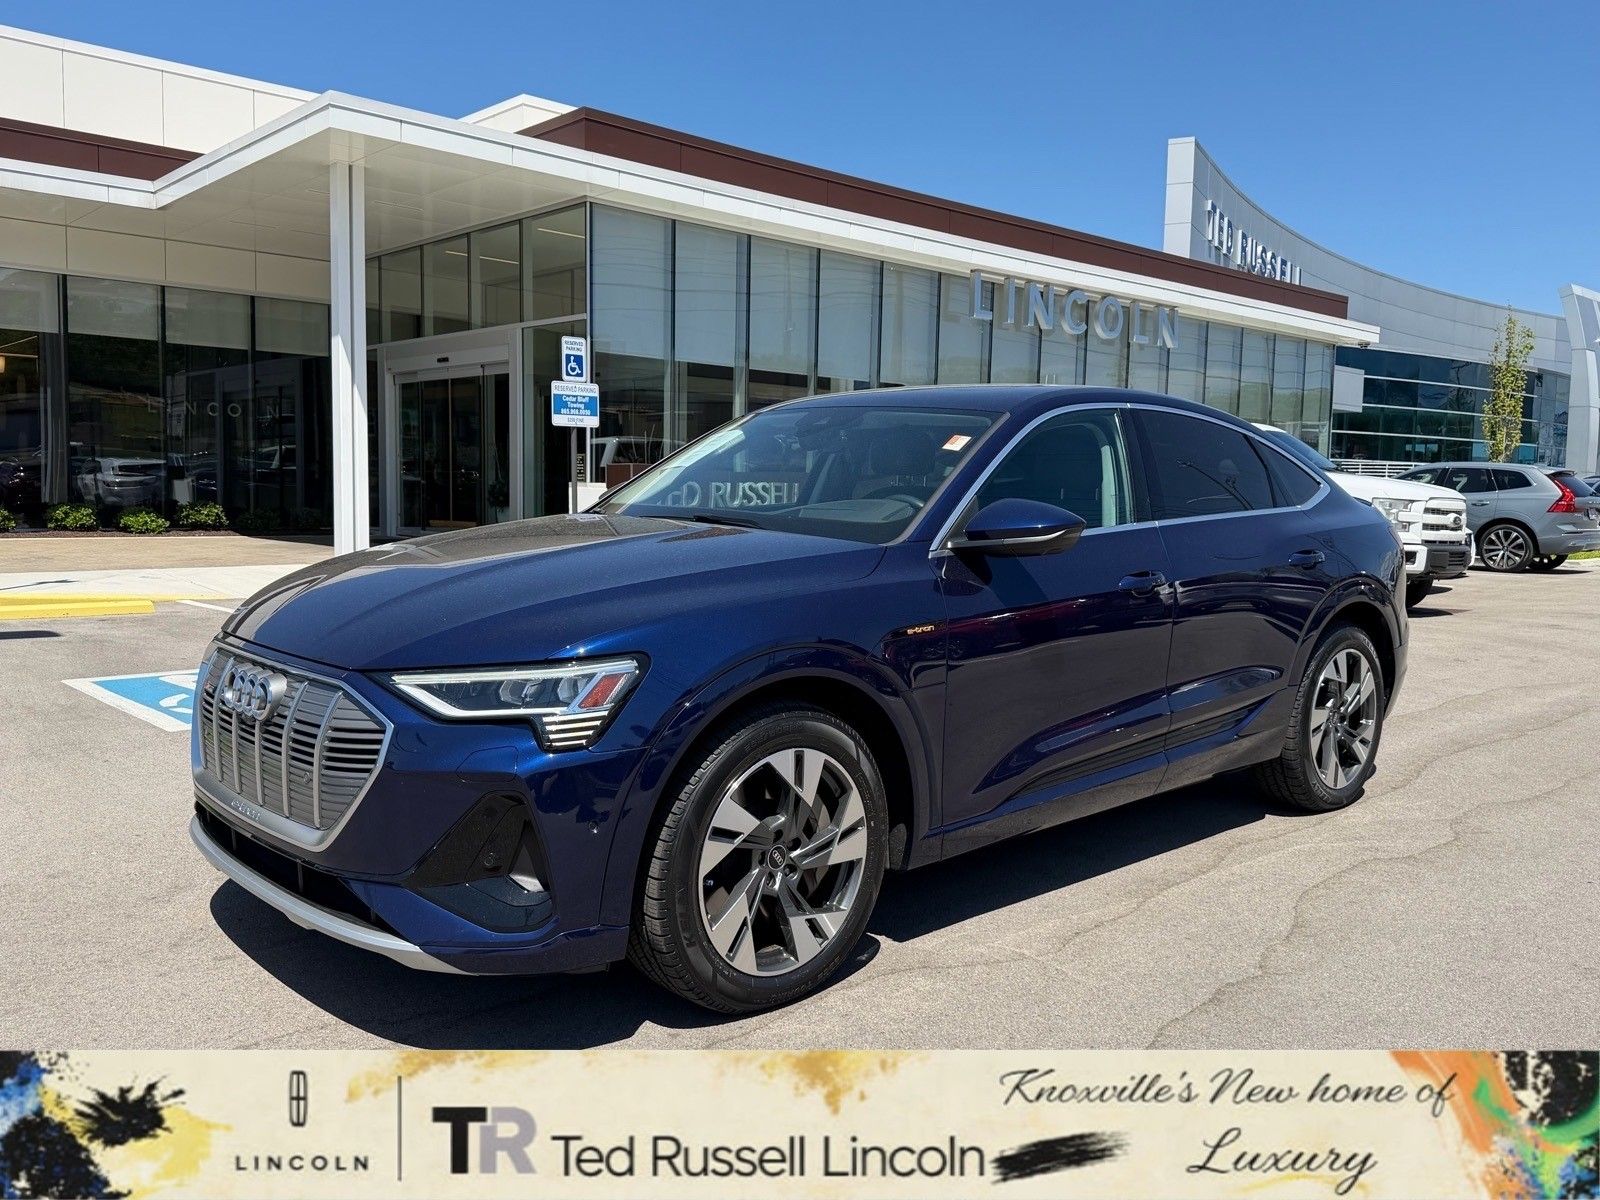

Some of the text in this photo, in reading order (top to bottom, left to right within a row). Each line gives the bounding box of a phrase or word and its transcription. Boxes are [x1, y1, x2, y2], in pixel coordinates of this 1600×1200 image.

[1205, 199, 1234, 257] TED
[969, 269, 1179, 349] LINCOLN
[554, 384, 597, 394] RESERVED PARKING
[147, 398, 280, 417] LINCON
[567, 401, 585, 410] Towing
[906, 625, 935, 635] e-tron
